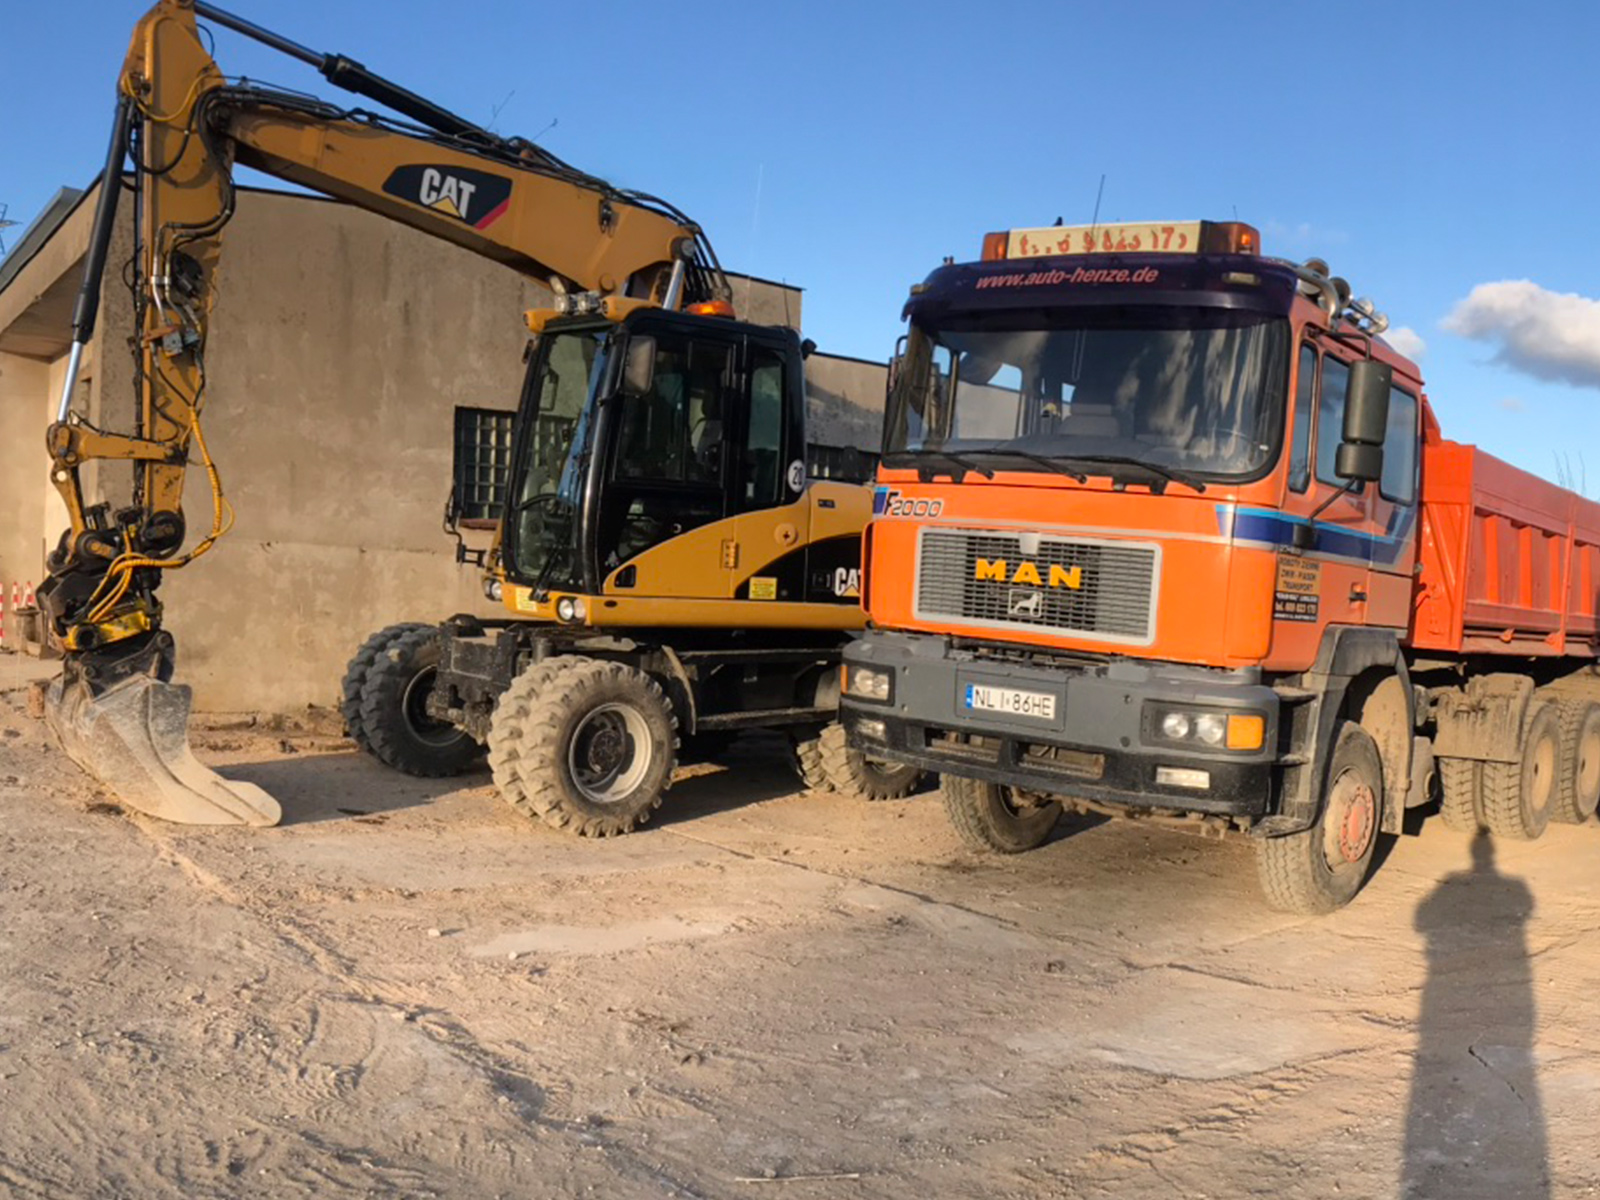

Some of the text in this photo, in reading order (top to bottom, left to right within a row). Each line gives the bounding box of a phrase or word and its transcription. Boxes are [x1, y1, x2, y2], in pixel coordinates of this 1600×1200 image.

[420, 167, 476, 219] CAT
[975, 265, 1160, 289] www.auto-henze.de
[883, 490, 944, 518] F2000
[834, 567, 862, 597] CA
[974, 557, 1083, 589] MAN
